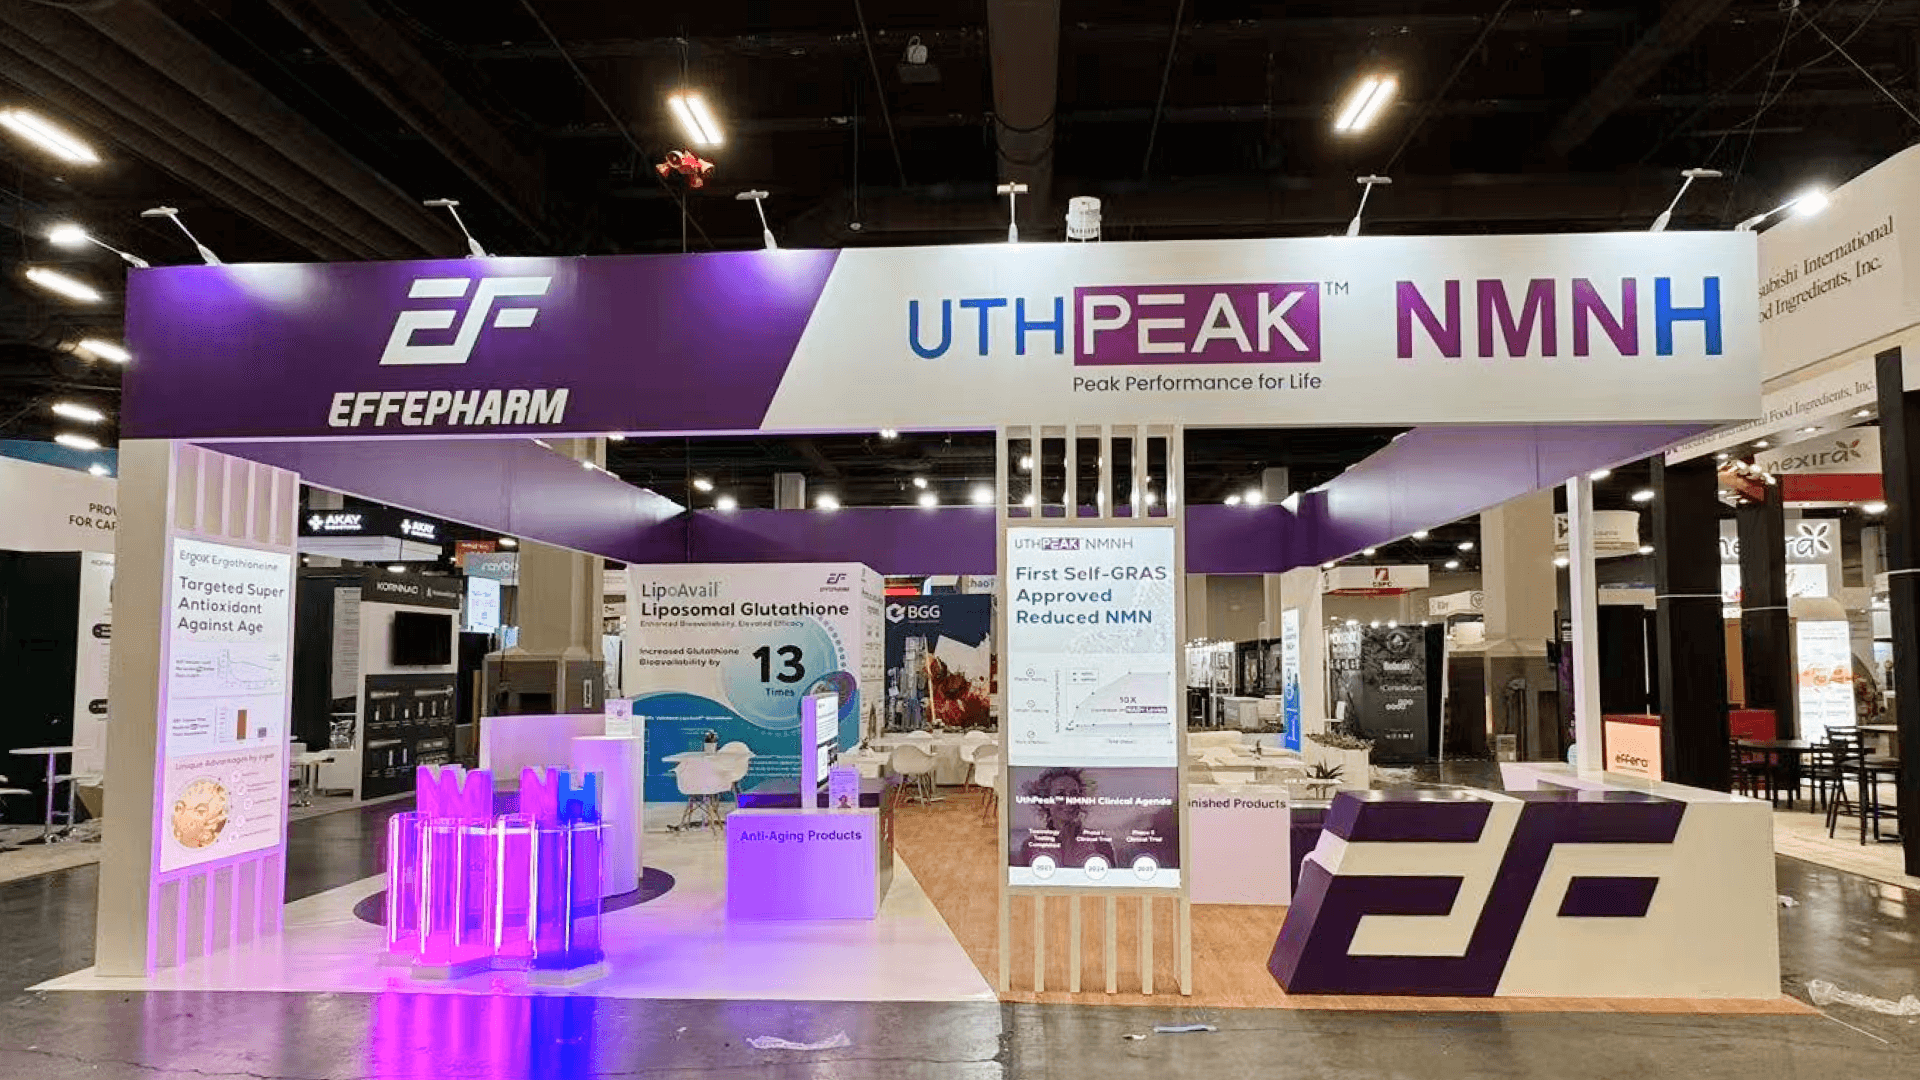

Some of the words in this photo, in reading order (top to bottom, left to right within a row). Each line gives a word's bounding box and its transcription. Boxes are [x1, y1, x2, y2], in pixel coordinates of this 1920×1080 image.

[1758, 266, 1798, 299] subishi
[1803, 215, 1894, 275] International
[1775, 270, 1851, 314] Ingredients,
[1856, 254, 1882, 280] Inc.
[1397, 276, 1723, 358] NMNH
[1073, 376, 1120, 392] Peak
[1126, 375, 1253, 391] Performance
[1258, 373, 1285, 390] for
[1290, 373, 1322, 389] Life
[328, 388, 570, 427] EFFEPHARM
[1767, 448, 1849, 474] nexira
[69, 514, 93, 528] FOR
[325, 514, 362, 525] AKAY
[1085, 537, 1133, 549] NMNH
[1016, 566, 1058, 581] First
[1063, 566, 1167, 581] Self-GRAS
[179, 575, 244, 595] Targeted
[247, 583, 285, 599] Super
[178, 596, 263, 614] Antioxidant
[1016, 588, 1112, 606] Approved
[641, 602, 735, 619] Liposomal
[740, 602, 850, 617] Glutathione
[908, 604, 941, 619] BGG
[1016, 610, 1099, 624] Reduced
[1105, 610, 1152, 624] NMN
[177, 616, 234, 634] Against
[237, 620, 264, 635] Age
[639, 647, 685, 655] Increased
[686, 647, 740, 656] Glutathione
[709, 658, 721, 667] by
[752, 644, 806, 684] 13
[765, 687, 795, 697] Times
[1065, 796, 1096, 805] NMNH
[1098, 796, 1133, 805] Clinical
[1135, 797, 1173, 807] Agenda
[1233, 798, 1287, 809] Products
[740, 830, 804, 843] Anti-Aging
[808, 829, 862, 841] Products
